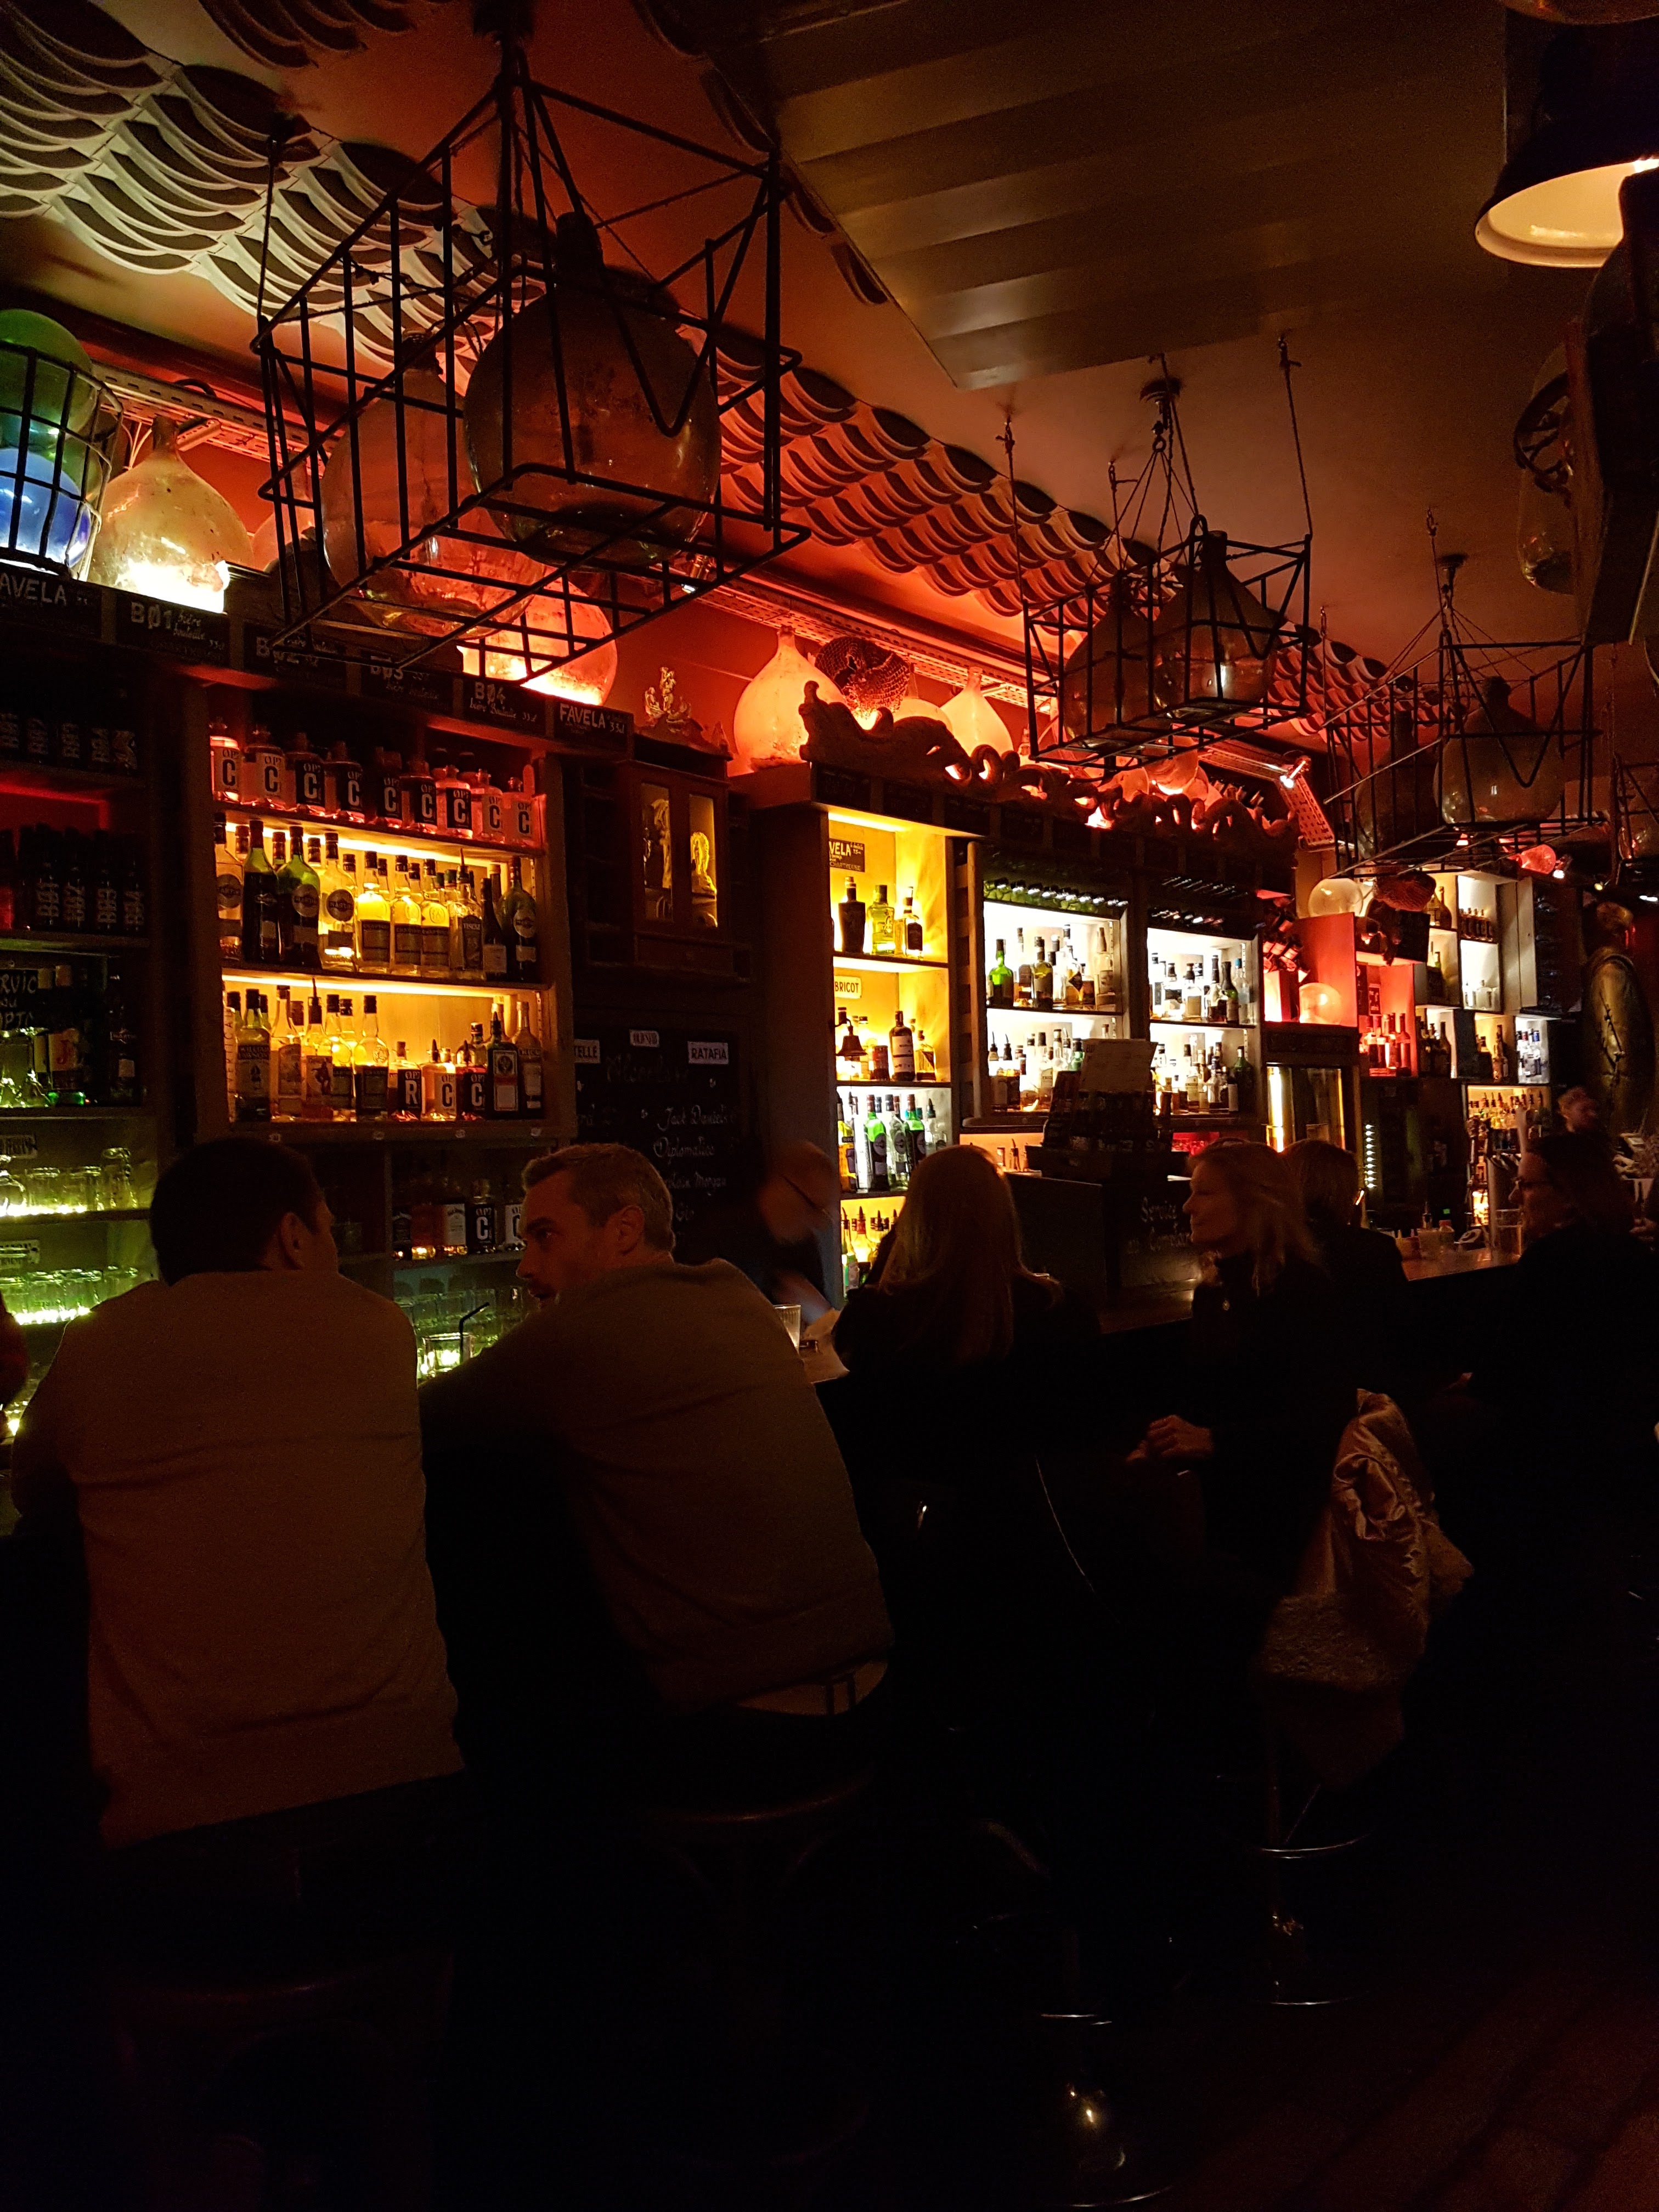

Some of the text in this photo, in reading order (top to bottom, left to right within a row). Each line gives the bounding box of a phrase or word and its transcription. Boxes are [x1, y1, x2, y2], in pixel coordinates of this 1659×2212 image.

[560, 703, 606, 729] FAVELA
[223, 759, 235, 786] C
[264, 766, 278, 792] C
[304, 773, 317, 799] C
[348, 780, 360, 806] C
[384, 787, 396, 812] C
[421, 793, 433, 819] C
[454, 798, 465, 823] C
[489, 805, 500, 828] C
[518, 811, 529, 834] C
[829, 840, 851, 856] VELA
[834, 981, 859, 993] BRICOT
[691, 1047, 727, 1060] RATAFIA
[405, 1080, 417, 1105] R
[442, 1083, 452, 1107] C
[471, 1082, 483, 1107] C
[476, 1216, 488, 1240] C
